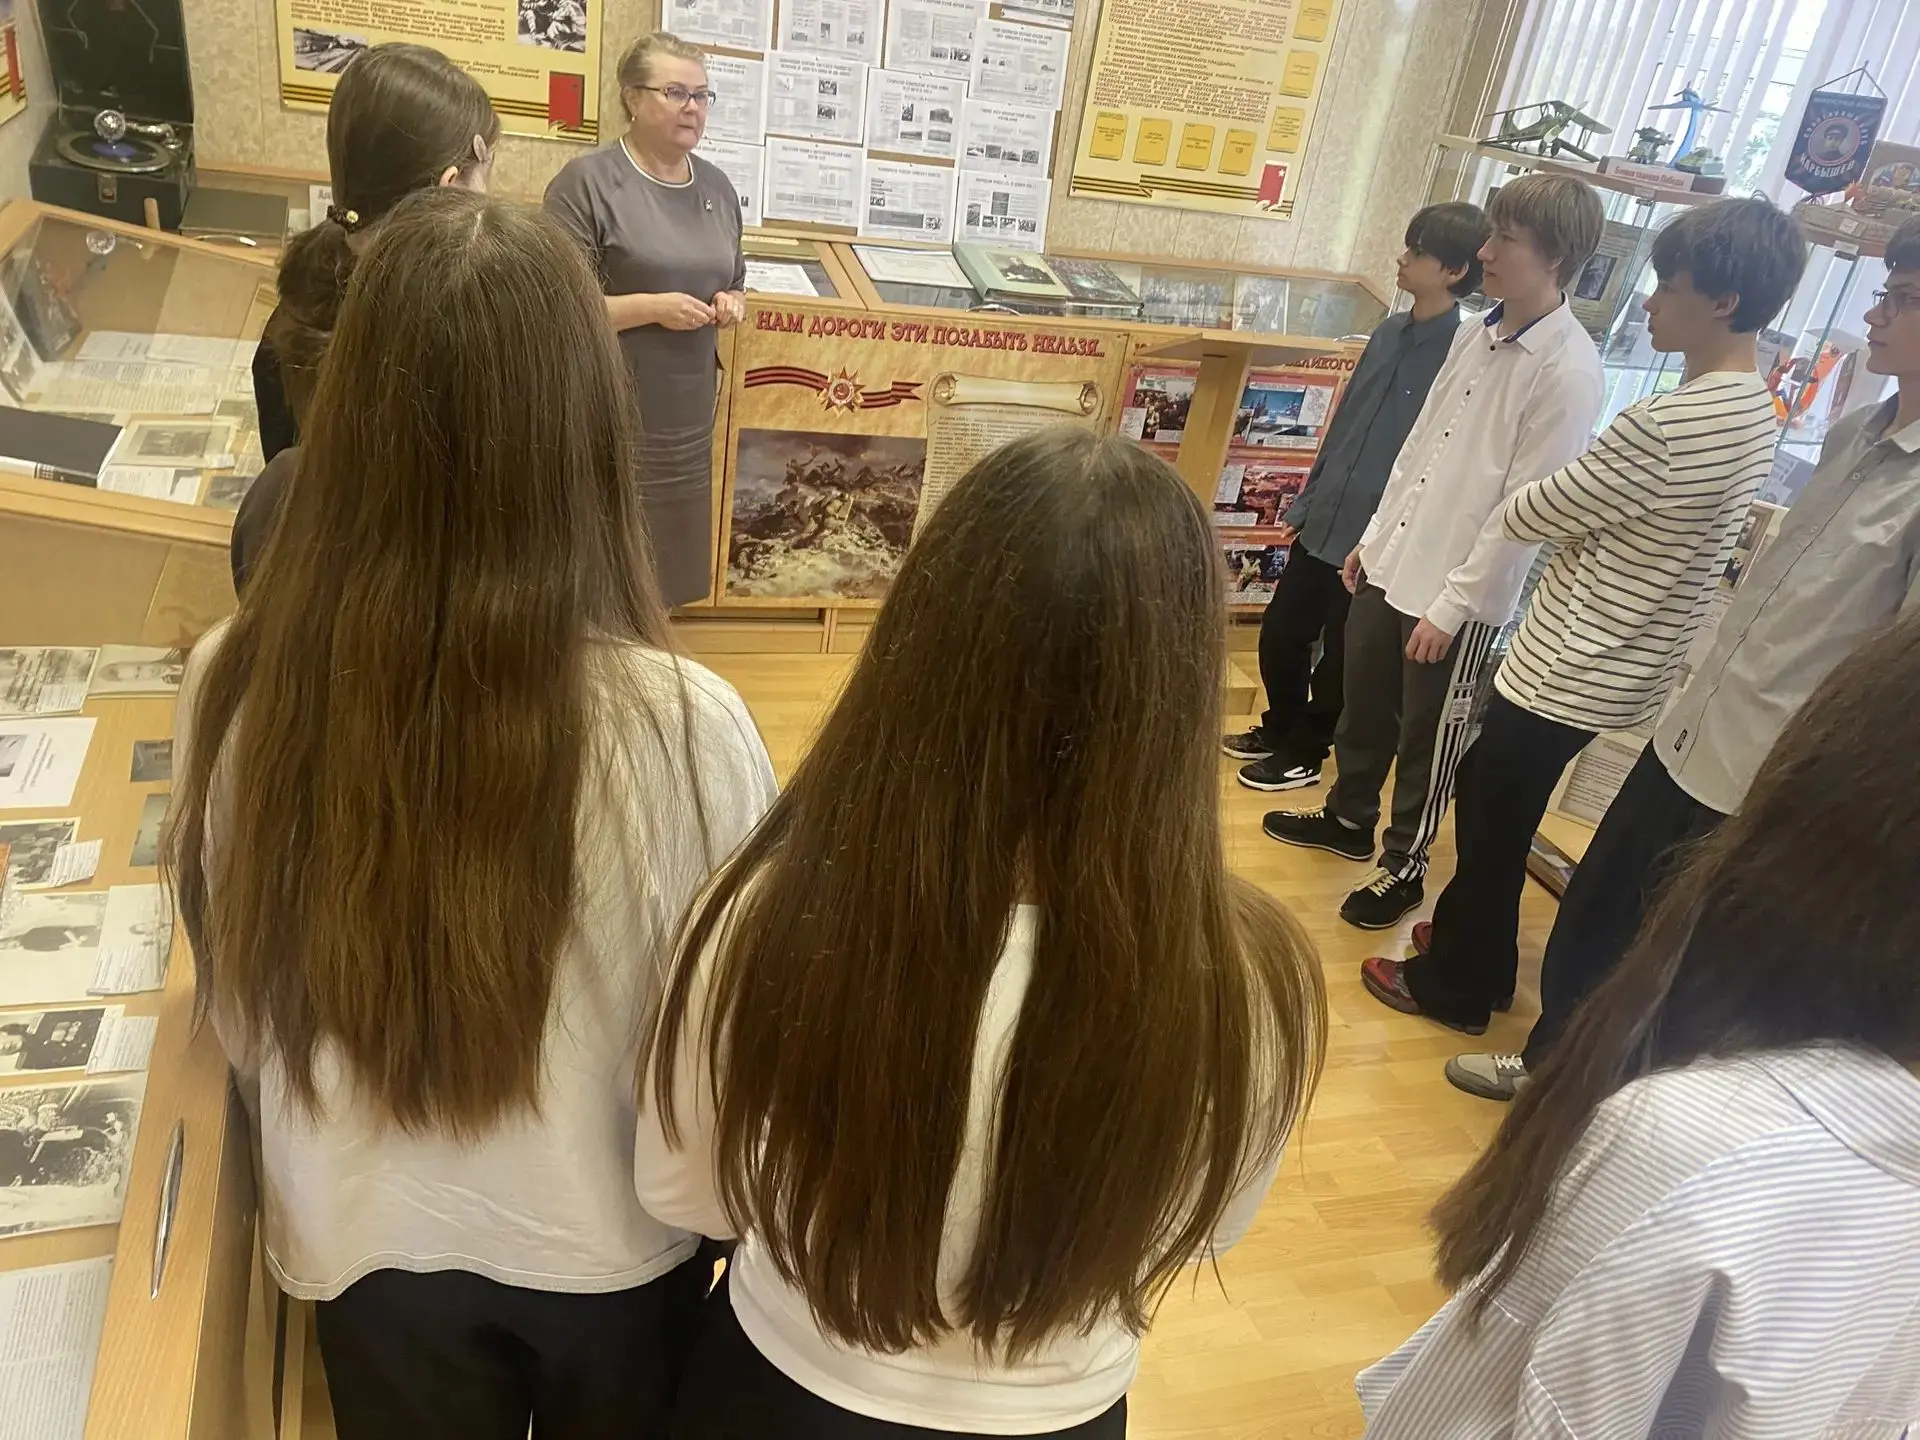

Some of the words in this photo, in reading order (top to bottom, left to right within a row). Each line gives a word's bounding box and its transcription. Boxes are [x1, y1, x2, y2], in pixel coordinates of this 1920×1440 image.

[756, 310, 805, 333] НАМ
[808, 316, 886, 340] ДОРОГИ
[891, 322, 929, 344] ЭТИ
[931, 325, 1028, 352] ПОЗАБЫТЬ
